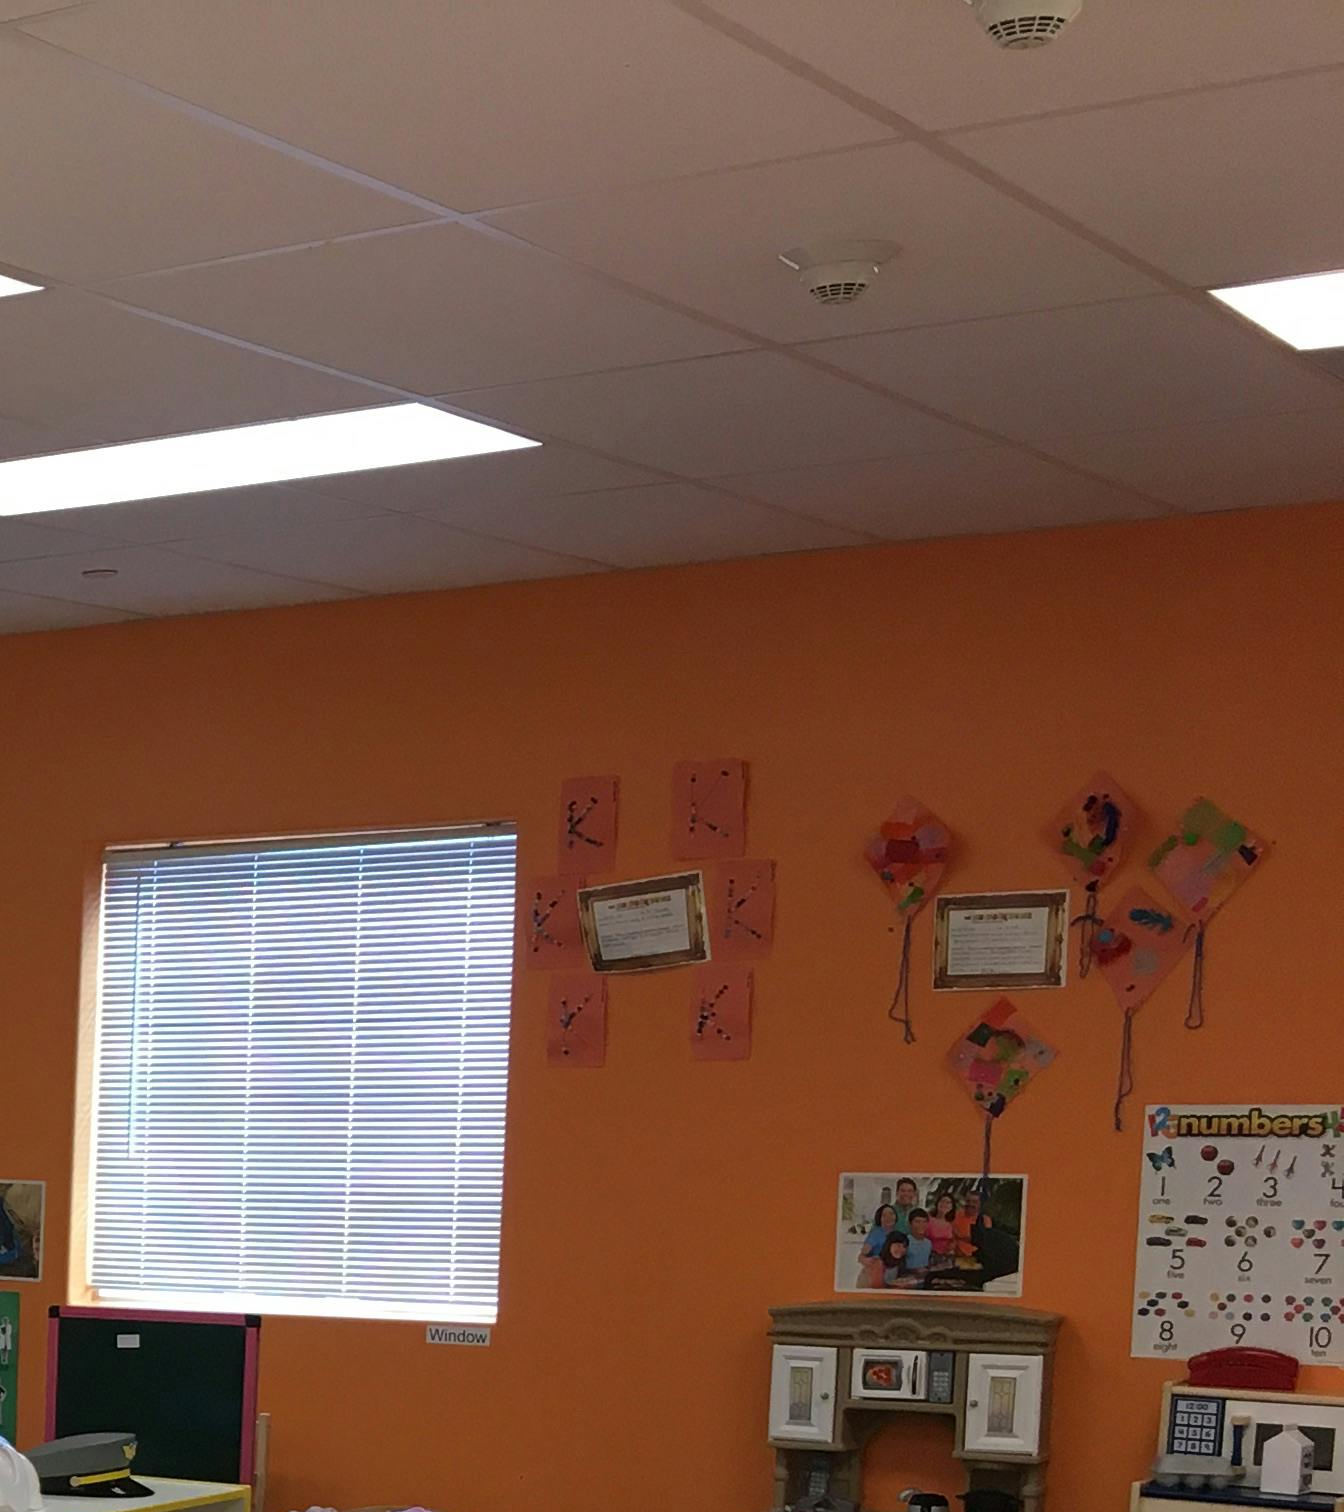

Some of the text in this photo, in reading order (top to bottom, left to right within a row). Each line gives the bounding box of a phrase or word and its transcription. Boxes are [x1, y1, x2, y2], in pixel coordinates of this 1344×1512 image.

[1177, 1107, 1326, 1138] numbers
[1160, 1176, 1166, 1197] 1
[1207, 1176, 1223, 1198] 2
[1263, 1176, 1278, 1199] 3
[1170, 1249, 1331, 1275] 5 6 7
[428, 1327, 488, 1344] Window
[1158, 1320, 1332, 1349] 8 9 10
